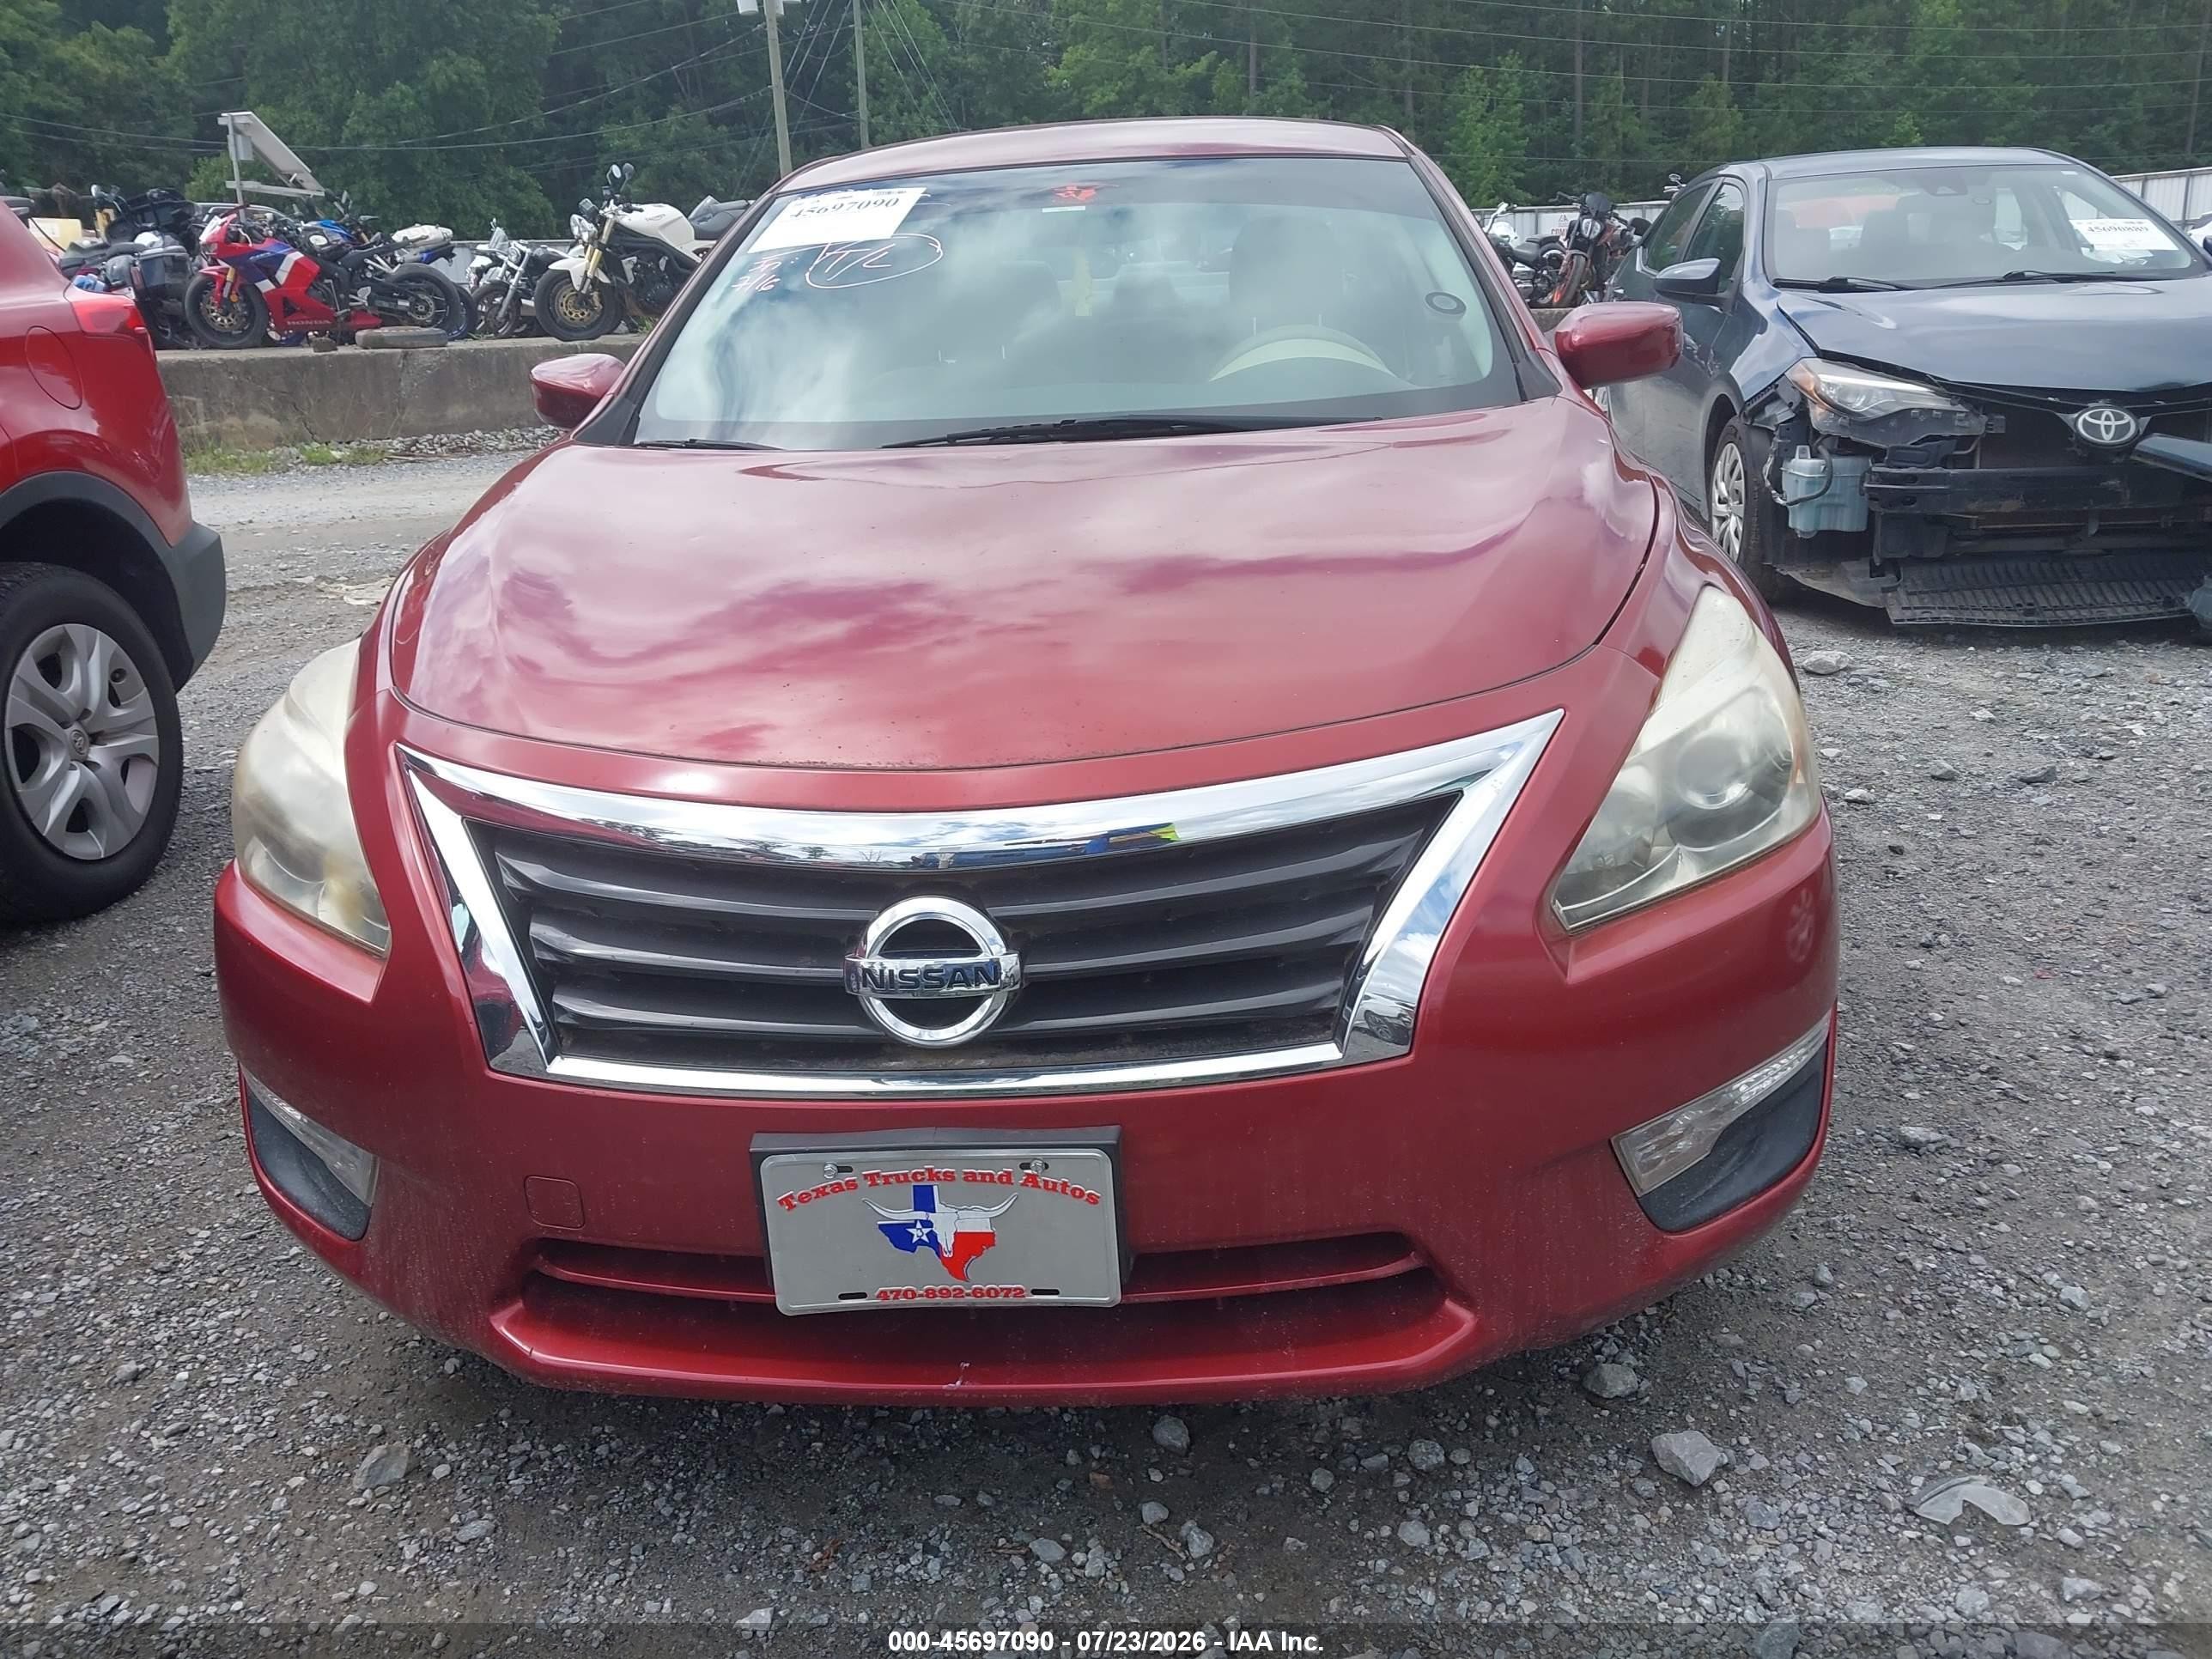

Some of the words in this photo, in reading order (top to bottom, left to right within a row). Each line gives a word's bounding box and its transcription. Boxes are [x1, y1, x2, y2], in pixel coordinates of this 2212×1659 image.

[790, 198, 900, 218] 45697090
[861, 964, 1001, 989] NISSAN
[776, 1176, 859, 1212] Texas
[861, 1165, 956, 1188] Trucks
[962, 1168, 1014, 1186] and
[1018, 1170, 1102, 1206] Autos
[875, 1285, 1026, 1301] 470-892-6072
